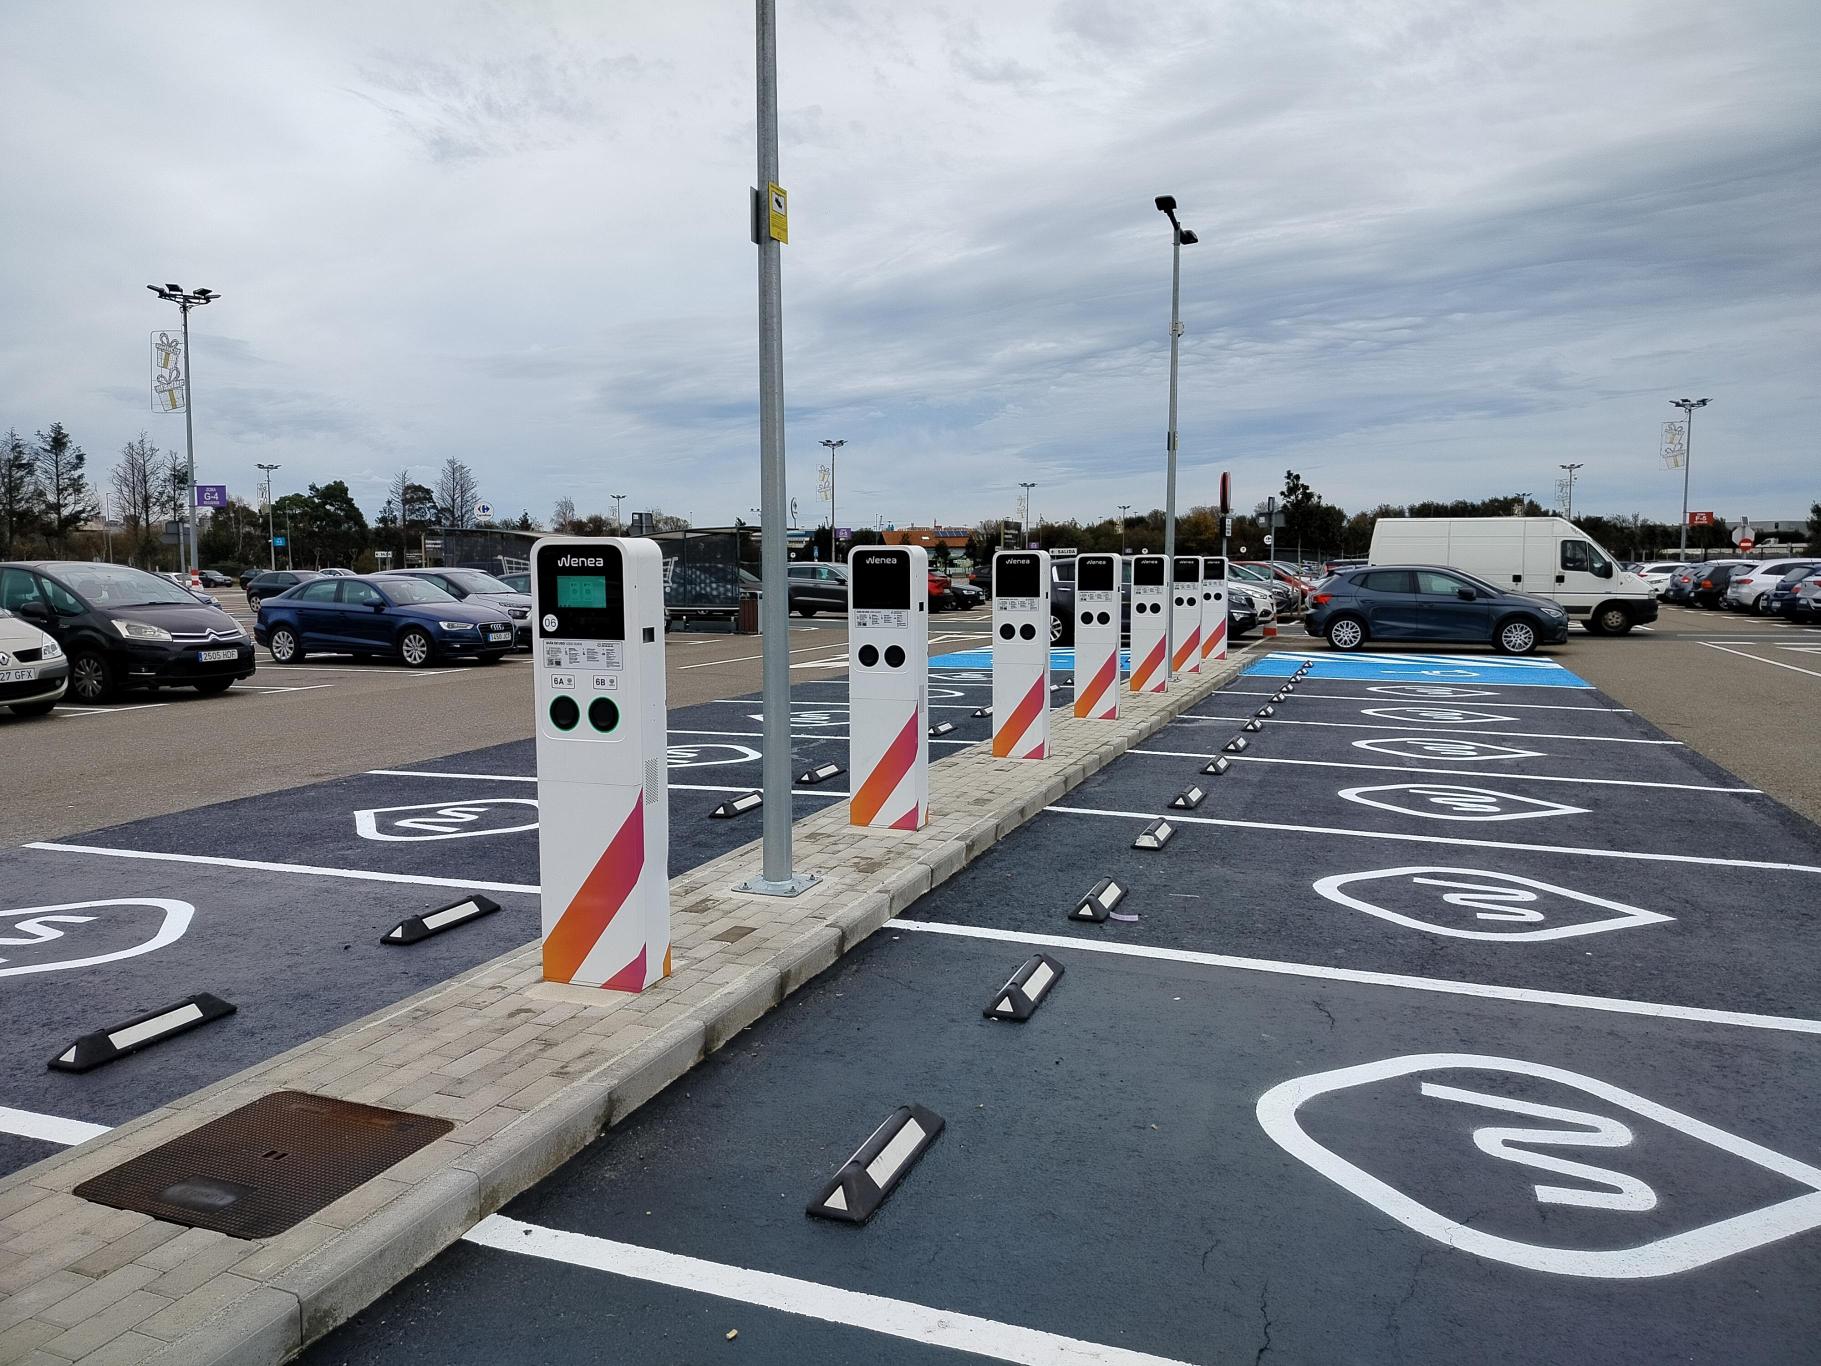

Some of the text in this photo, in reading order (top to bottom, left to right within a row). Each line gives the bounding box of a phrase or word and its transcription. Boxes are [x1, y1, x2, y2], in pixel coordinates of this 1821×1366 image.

[204, 492, 219, 501] G-4
[557, 554, 604, 567] Wenea
[865, 556, 898, 565] Wenea
[544, 618, 557, 628] 06
[203, 652, 222, 661] 2505
[14, 670, 33, 680] GFX
[553, 677, 565, 686] 6A
[595, 678, 606, 686] 6B
